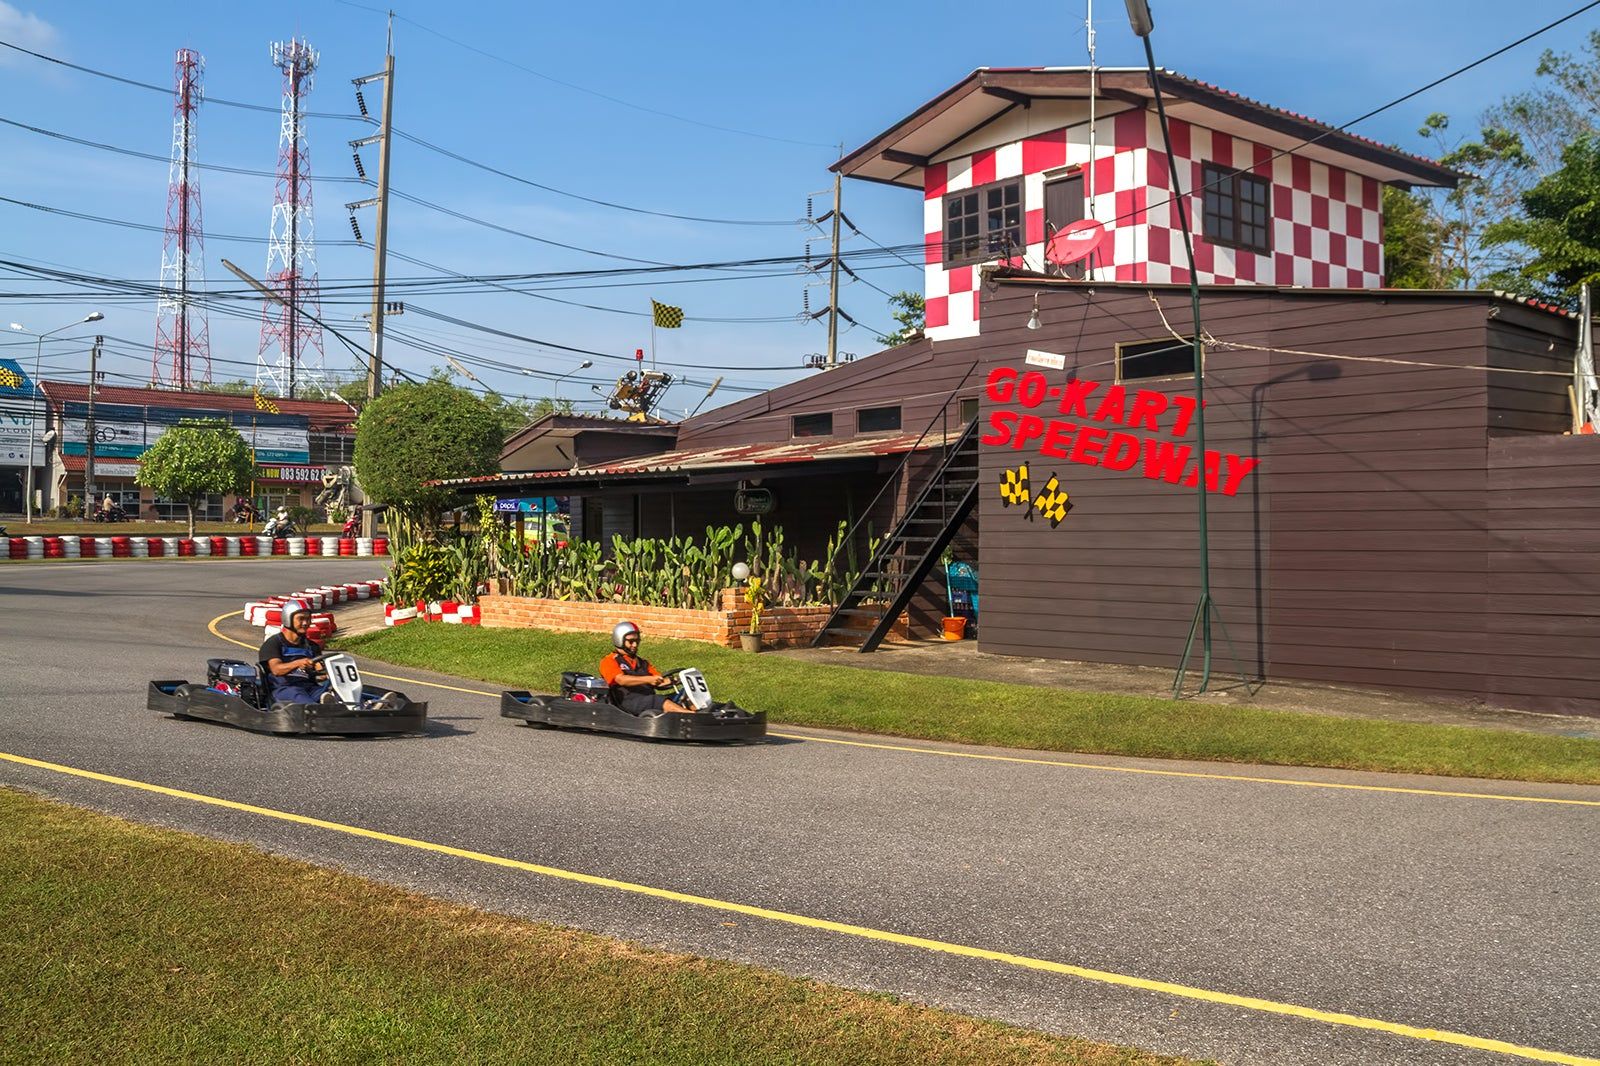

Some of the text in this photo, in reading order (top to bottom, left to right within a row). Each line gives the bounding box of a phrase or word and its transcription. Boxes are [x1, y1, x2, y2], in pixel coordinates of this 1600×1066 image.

[986, 367, 1206, 438] GO-KART
[280, 467, 294, 480] 083
[295, 468, 310, 481] 592
[310, 468, 320, 481] 62
[981, 410, 1262, 497] SPEEDWAY
